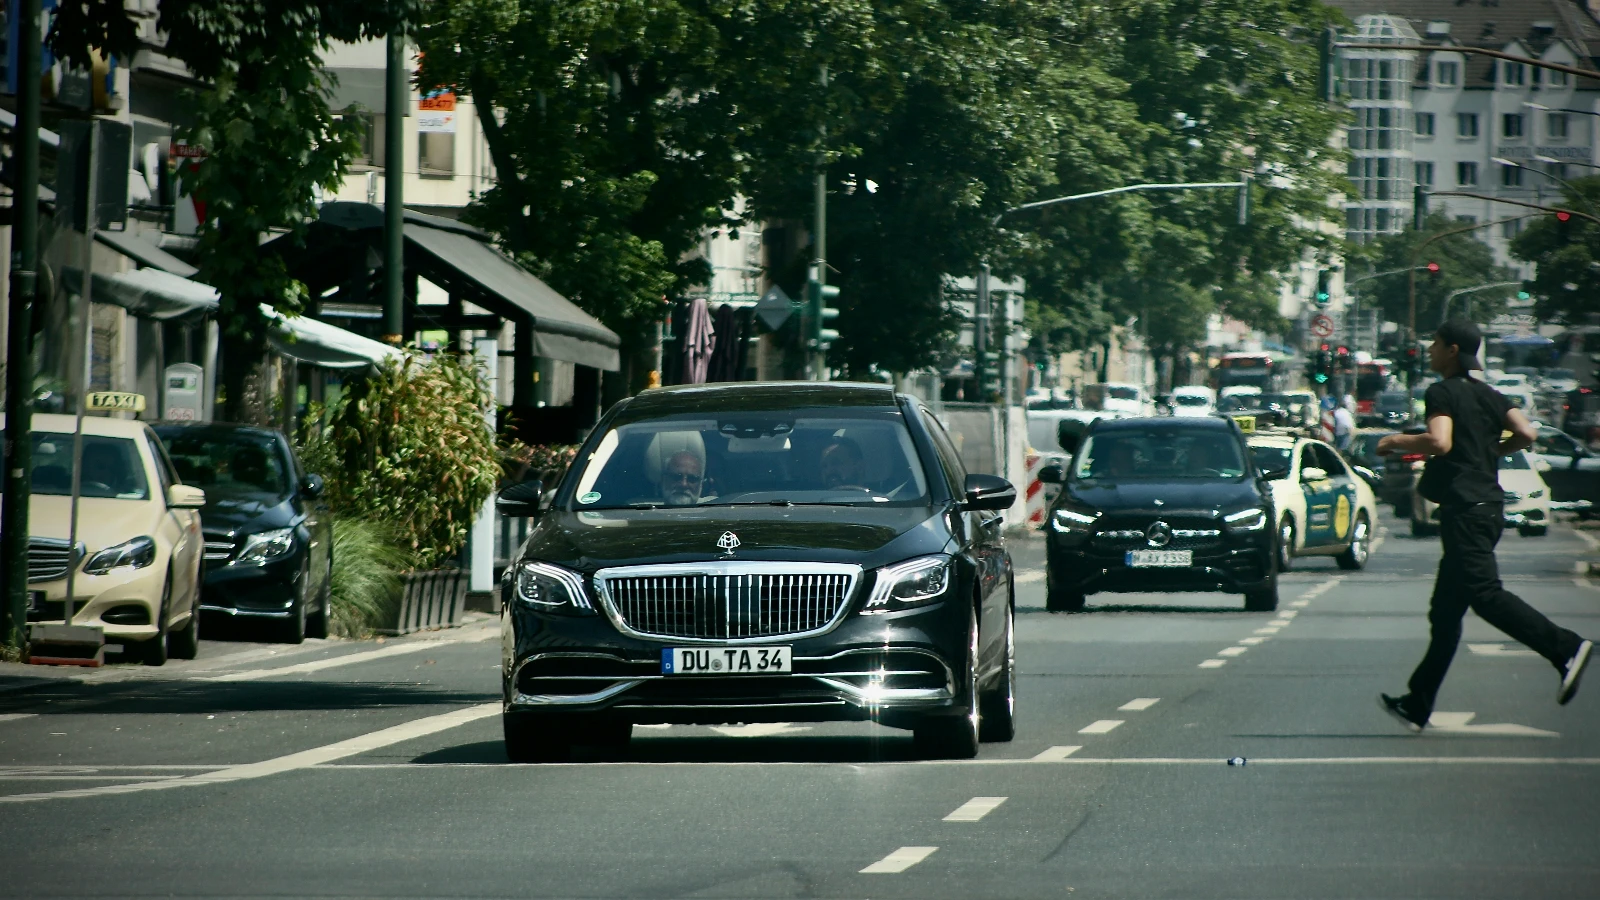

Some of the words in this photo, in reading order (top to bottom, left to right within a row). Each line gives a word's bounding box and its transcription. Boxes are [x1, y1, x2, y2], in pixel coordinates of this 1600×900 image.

[93, 395, 136, 408] TAXI
[682, 650, 709, 670] DU
[724, 650, 751, 670] TA
[757, 649, 782, 670] 34
